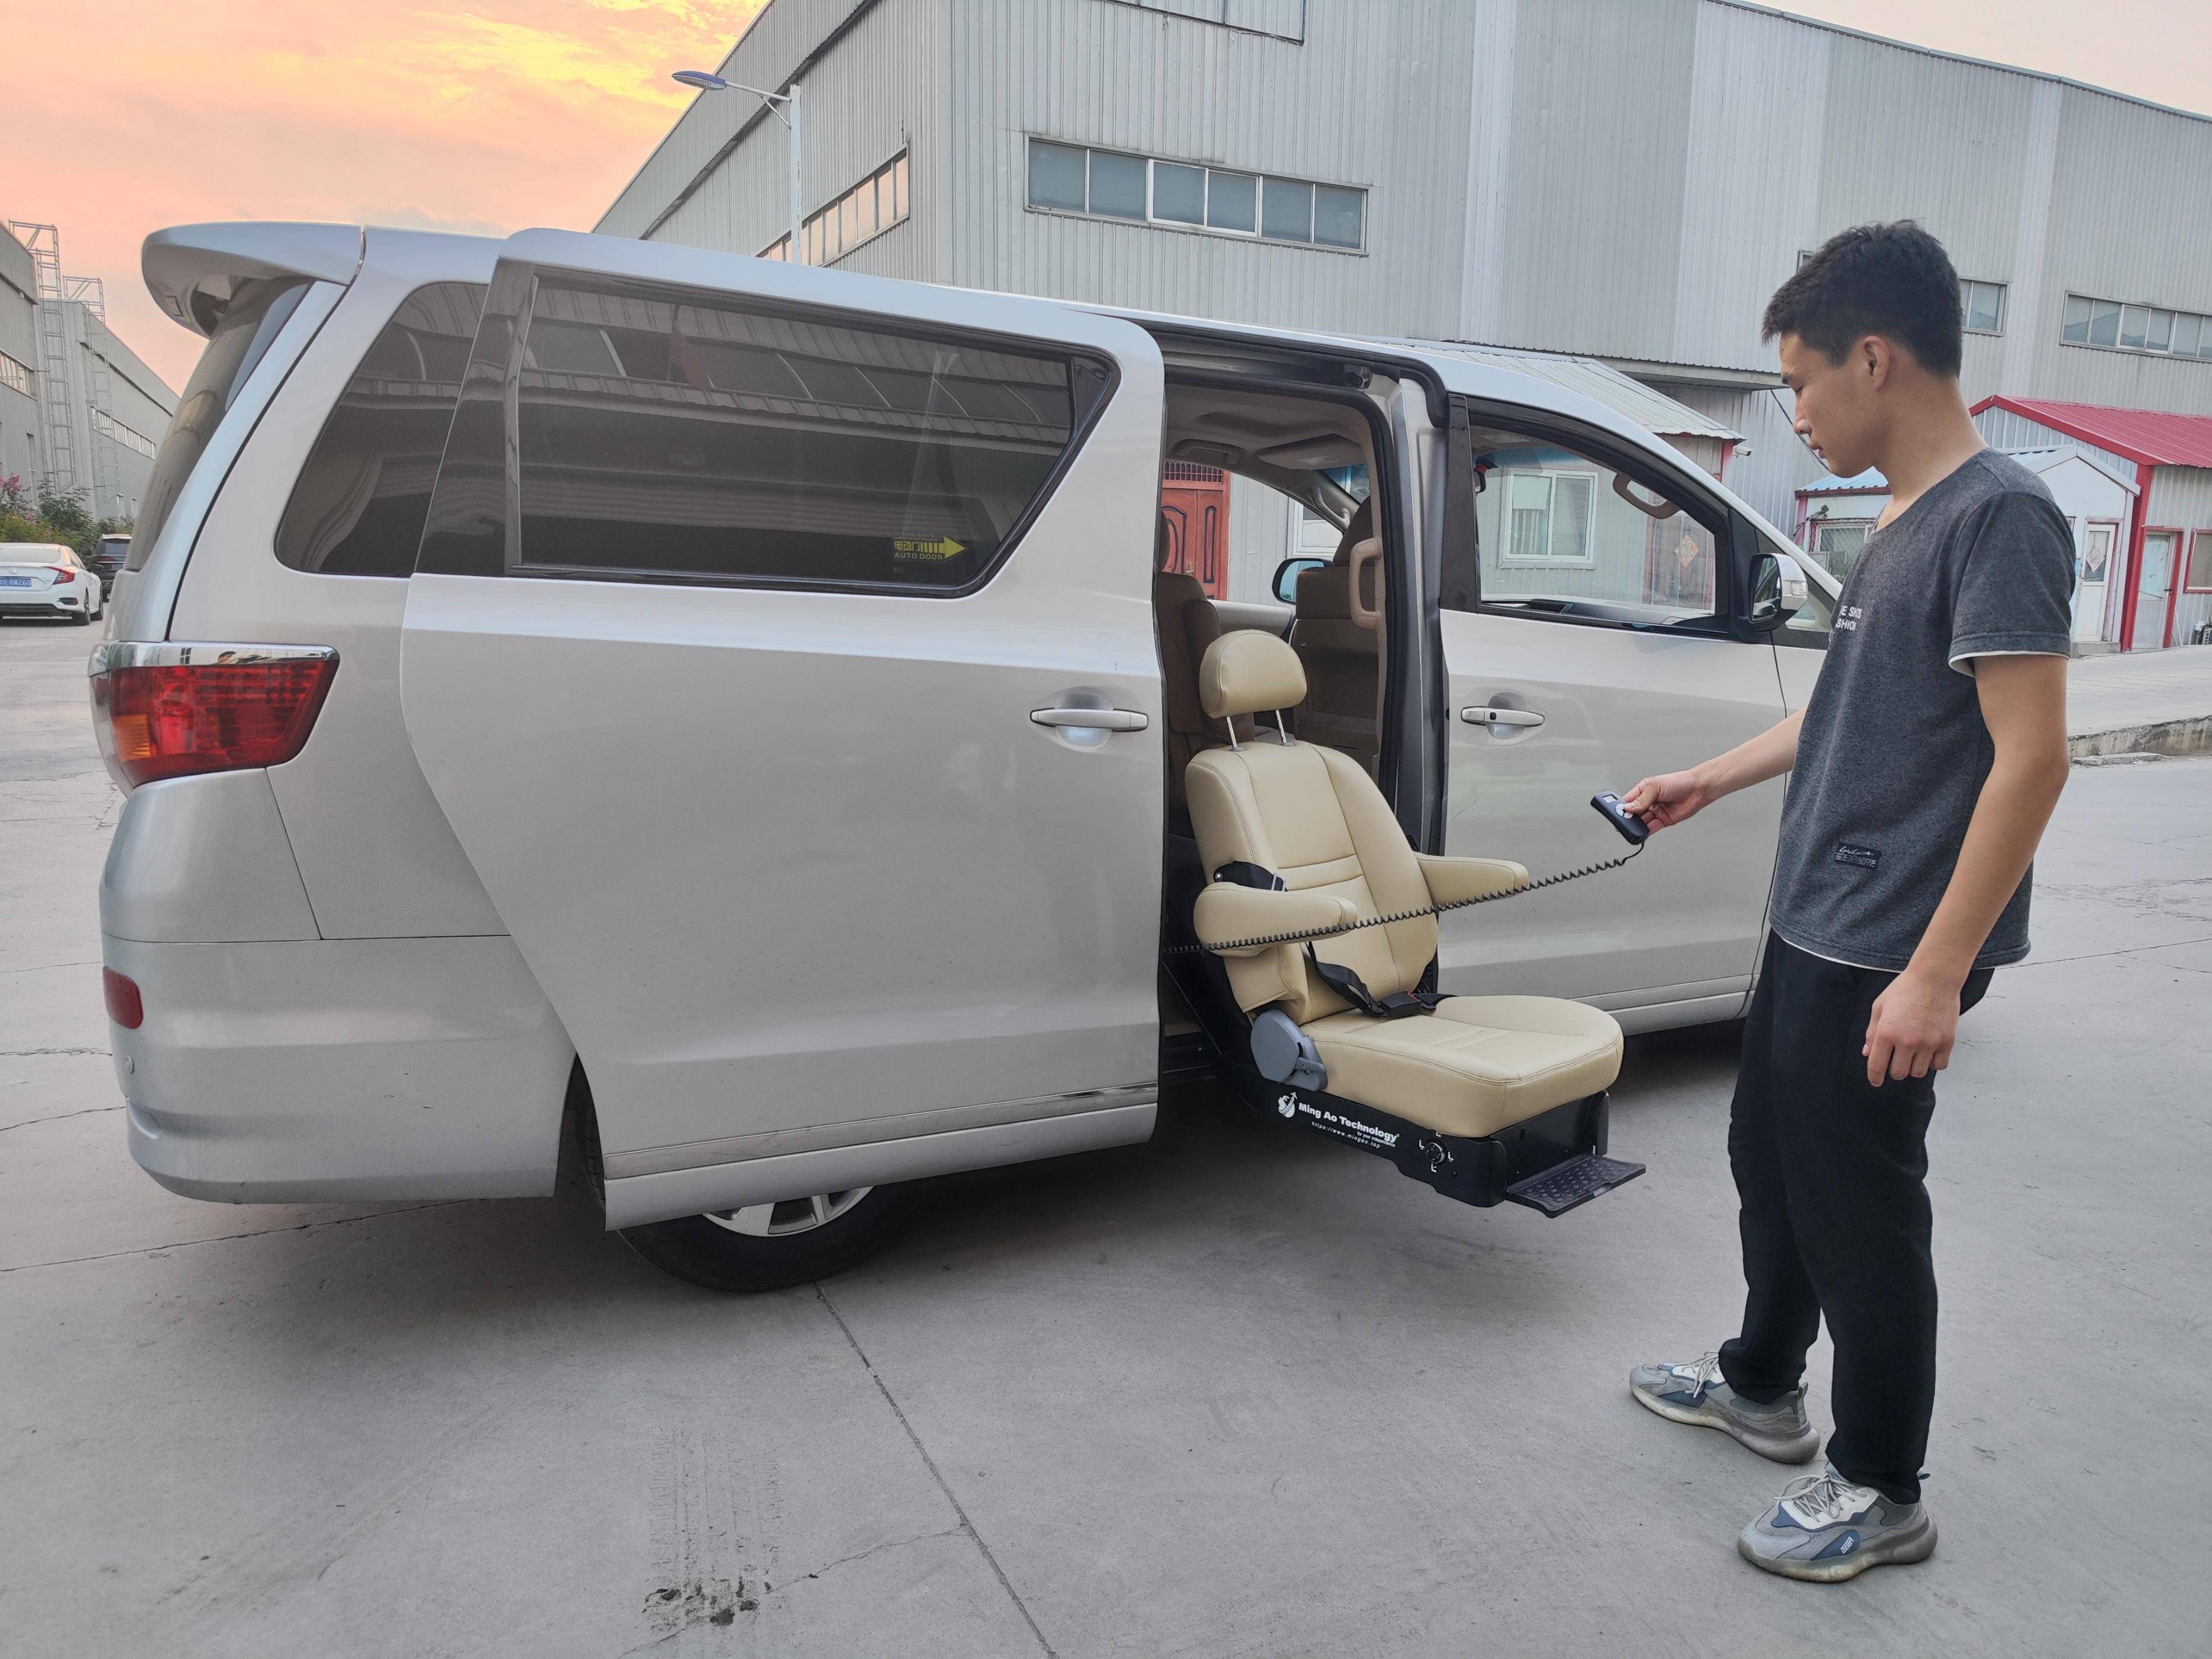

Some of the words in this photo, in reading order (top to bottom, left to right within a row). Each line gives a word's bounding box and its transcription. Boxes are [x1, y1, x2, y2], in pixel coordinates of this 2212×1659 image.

[1299, 1103, 1322, 1119] Ming
[1323, 1111, 1338, 1122] Ao
[1339, 1115, 1397, 1143] Technology
